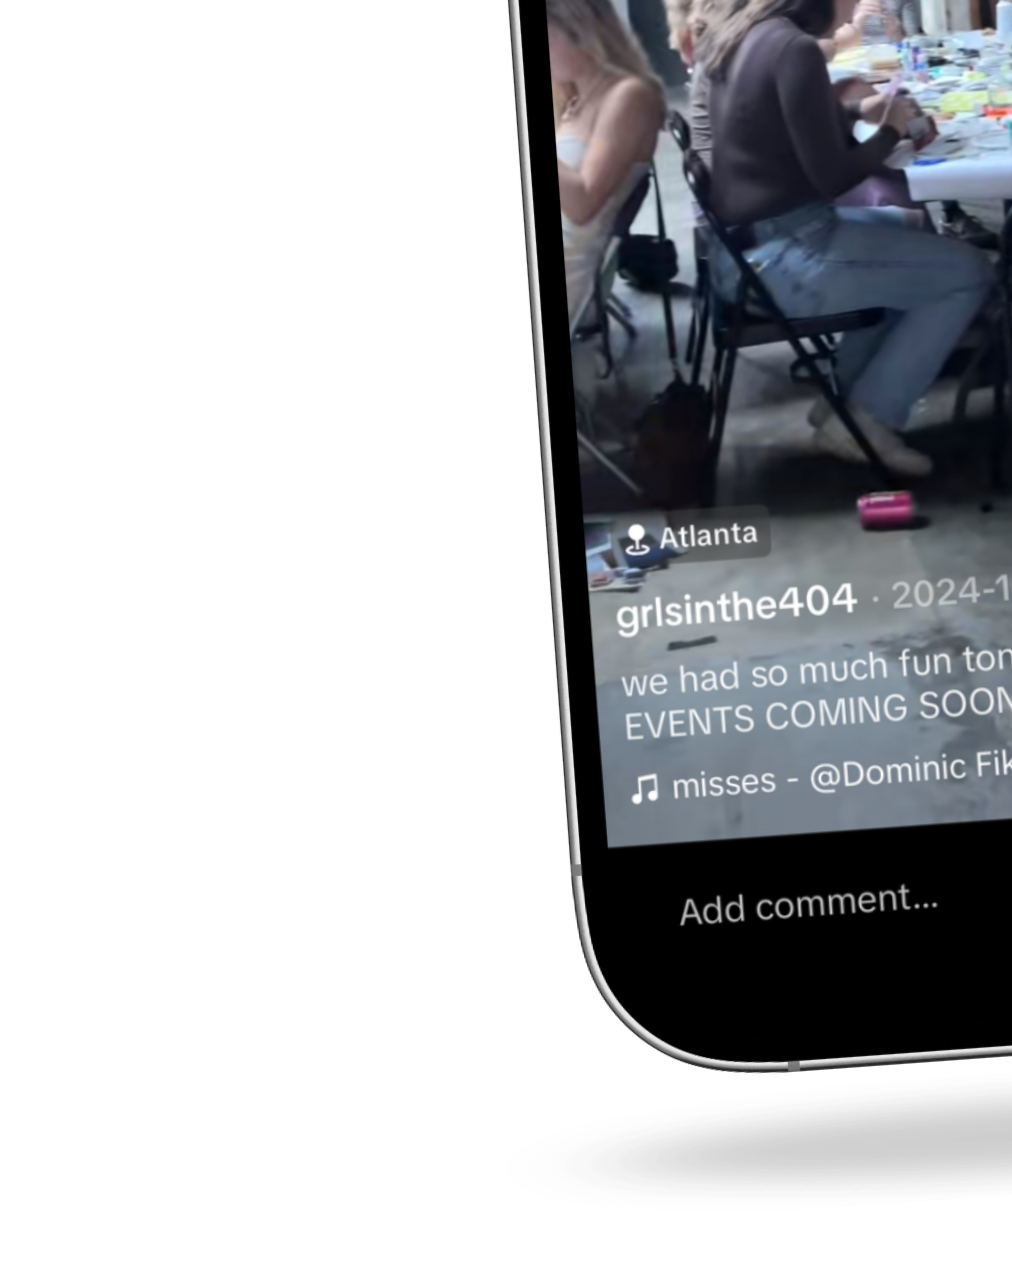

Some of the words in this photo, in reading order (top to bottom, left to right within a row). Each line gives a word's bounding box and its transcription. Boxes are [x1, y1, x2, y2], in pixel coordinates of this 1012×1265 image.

[659, 522, 759, 550] Atlanta
[616, 582, 858, 638] grlsinthe404
[621, 671, 668, 697] we
[679, 661, 740, 693] had
[751, 664, 788, 688] so
[800, 651, 888, 685] much
[898, 648, 952, 677] fun
[625, 704, 755, 741] EVENTS
[765, 693, 908, 730] COMING
[673, 770, 777, 800] misses
[810, 752, 967, 794] @Dominic
[679, 893, 745, 926] Add
[756, 883, 938, 921] comment...
